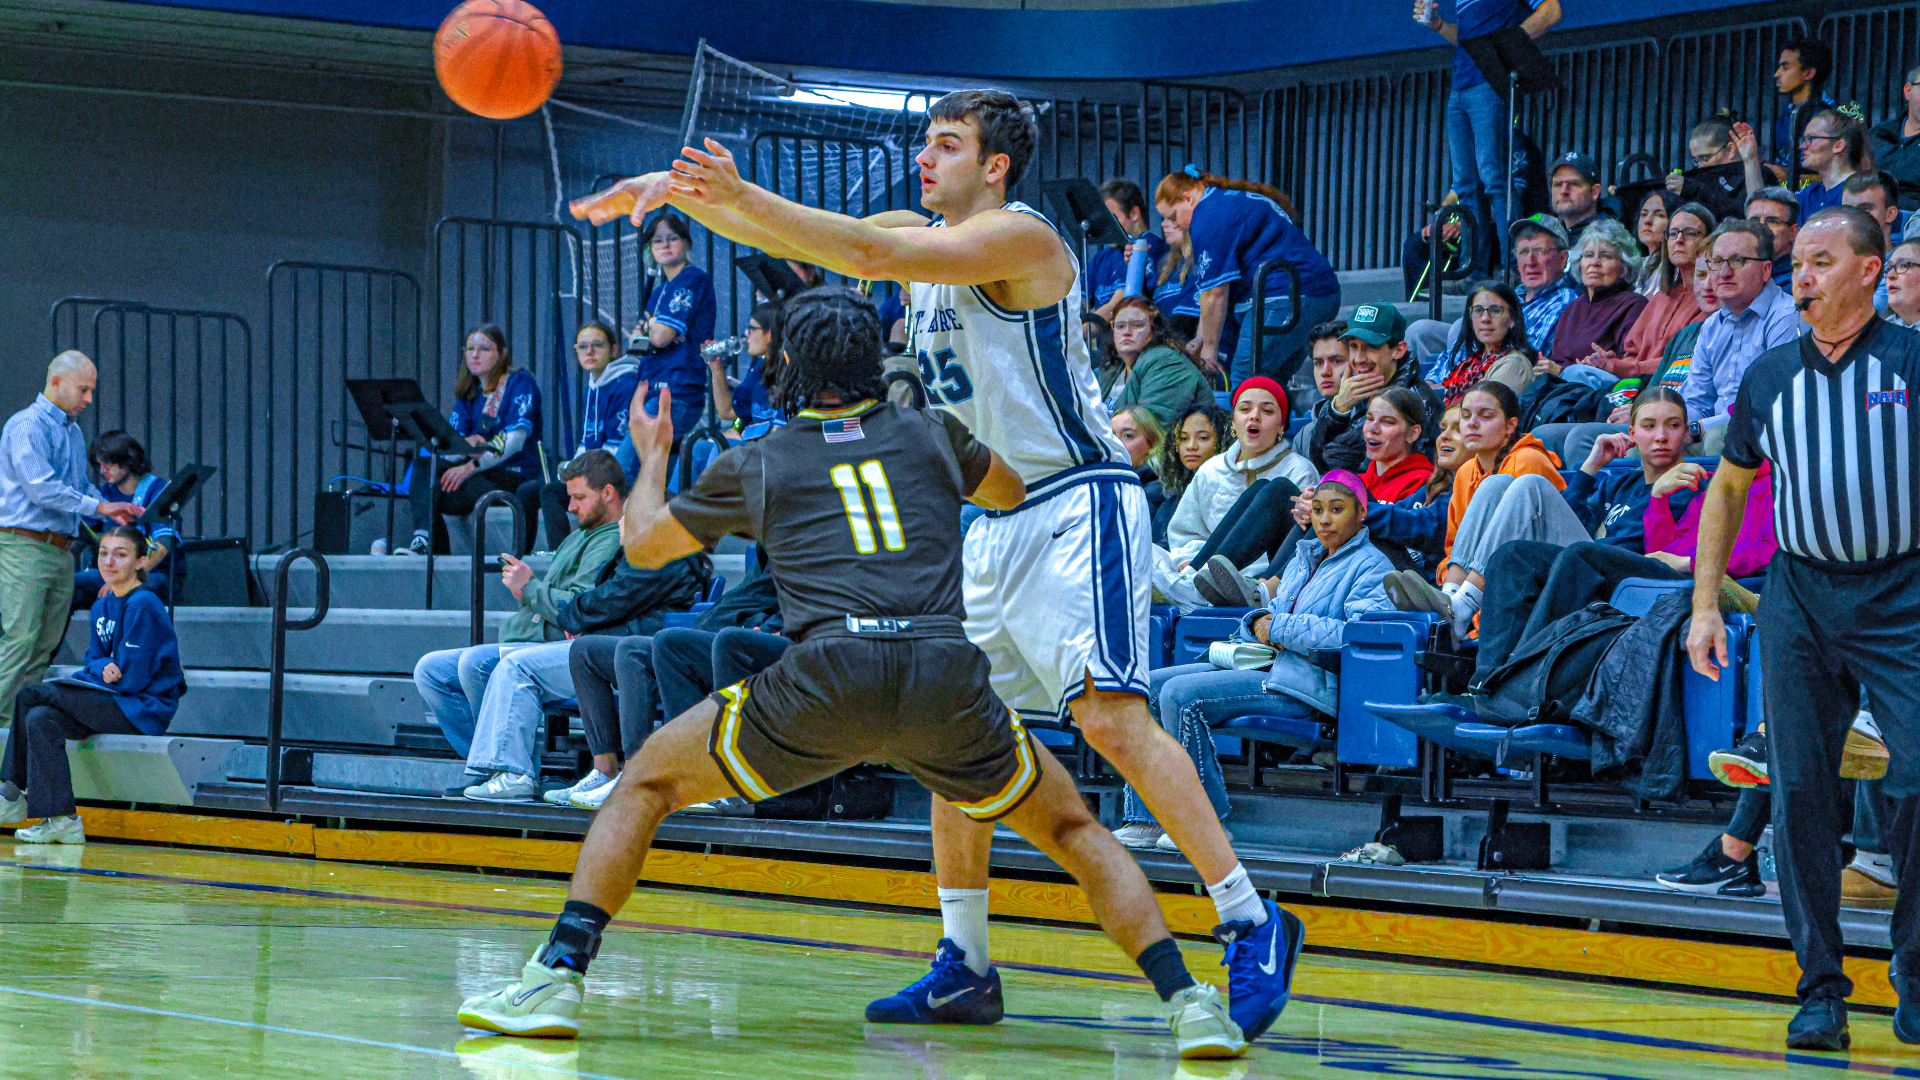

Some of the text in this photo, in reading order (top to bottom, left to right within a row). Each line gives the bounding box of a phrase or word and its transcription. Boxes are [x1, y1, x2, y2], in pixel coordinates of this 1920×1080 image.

[917, 348, 974, 405] 25
[1866, 390, 1909, 410] NAIA
[829, 459, 907, 555] 11
